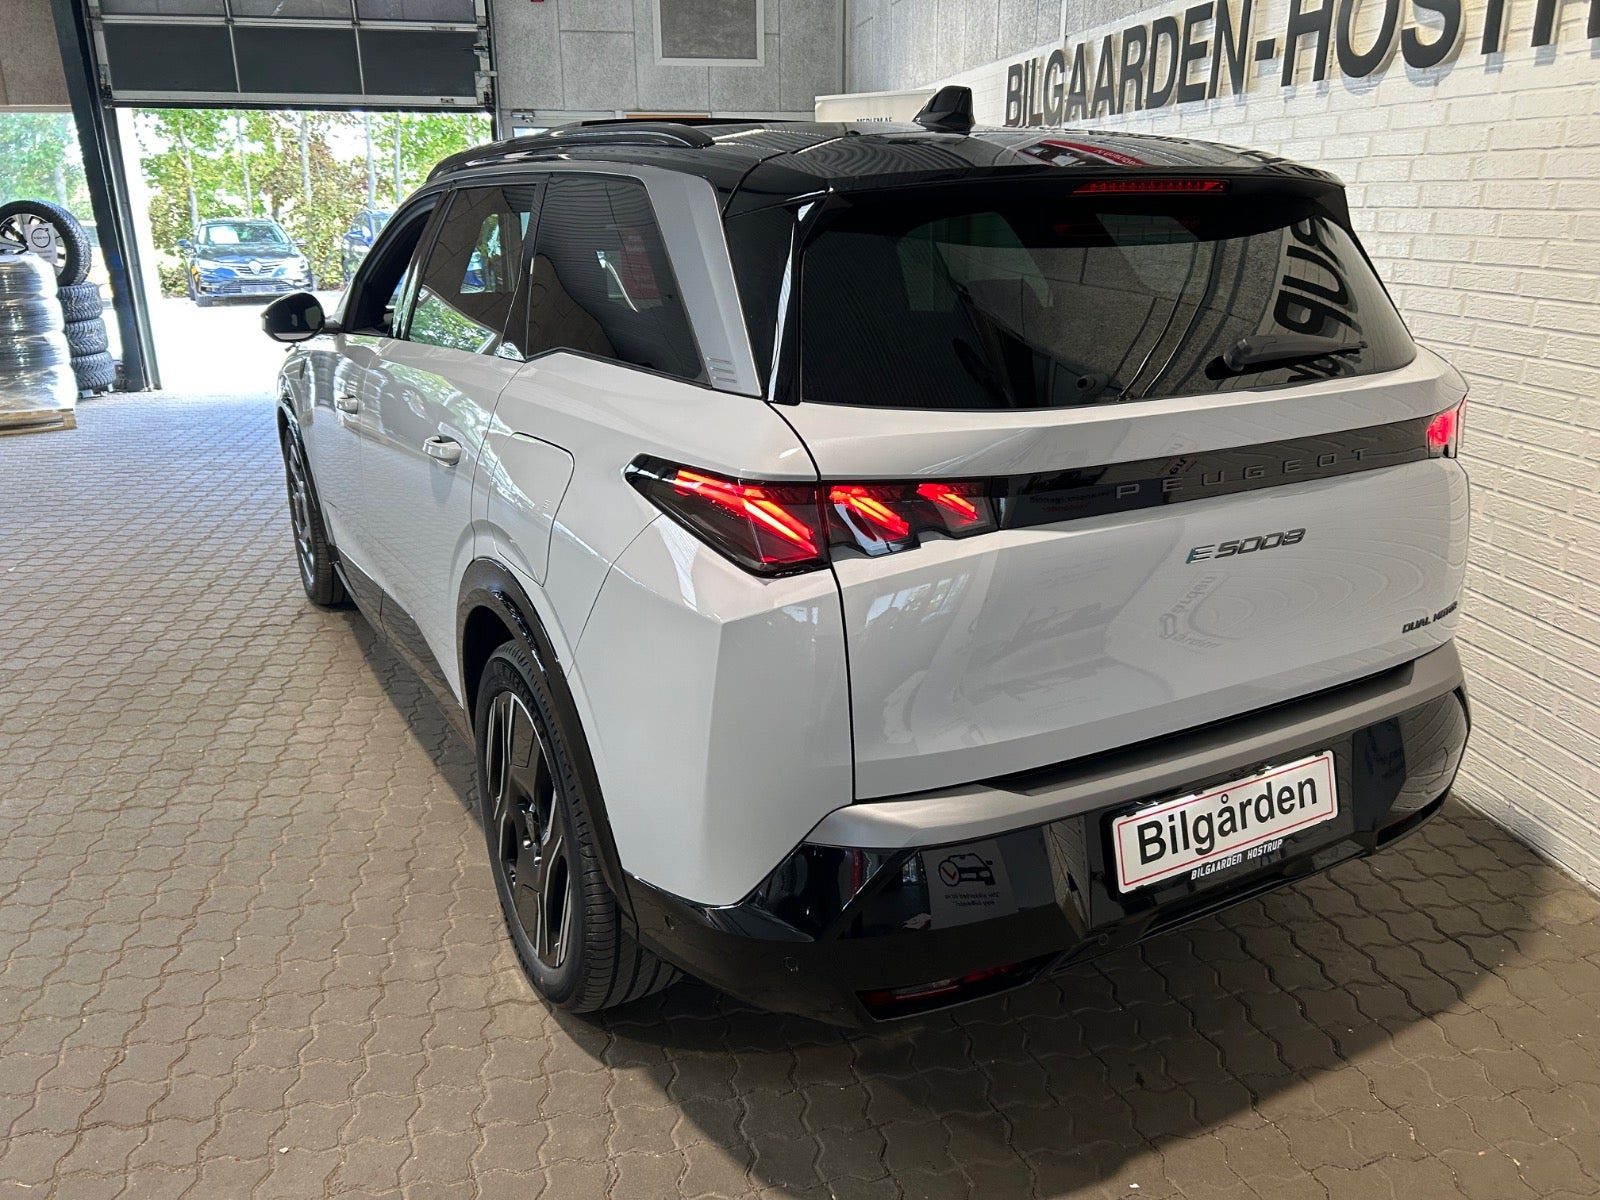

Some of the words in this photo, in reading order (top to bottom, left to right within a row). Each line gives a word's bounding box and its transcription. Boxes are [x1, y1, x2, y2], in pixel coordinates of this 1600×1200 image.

[1115, 448, 1369, 499] PEUGEOT
[1402, 617, 1431, 634] DUAL
[1137, 777, 1317, 865] Bilgården
[1191, 853, 1242, 881] BILGAARDEN
[1247, 839, 1283, 860] HOSTRUP
